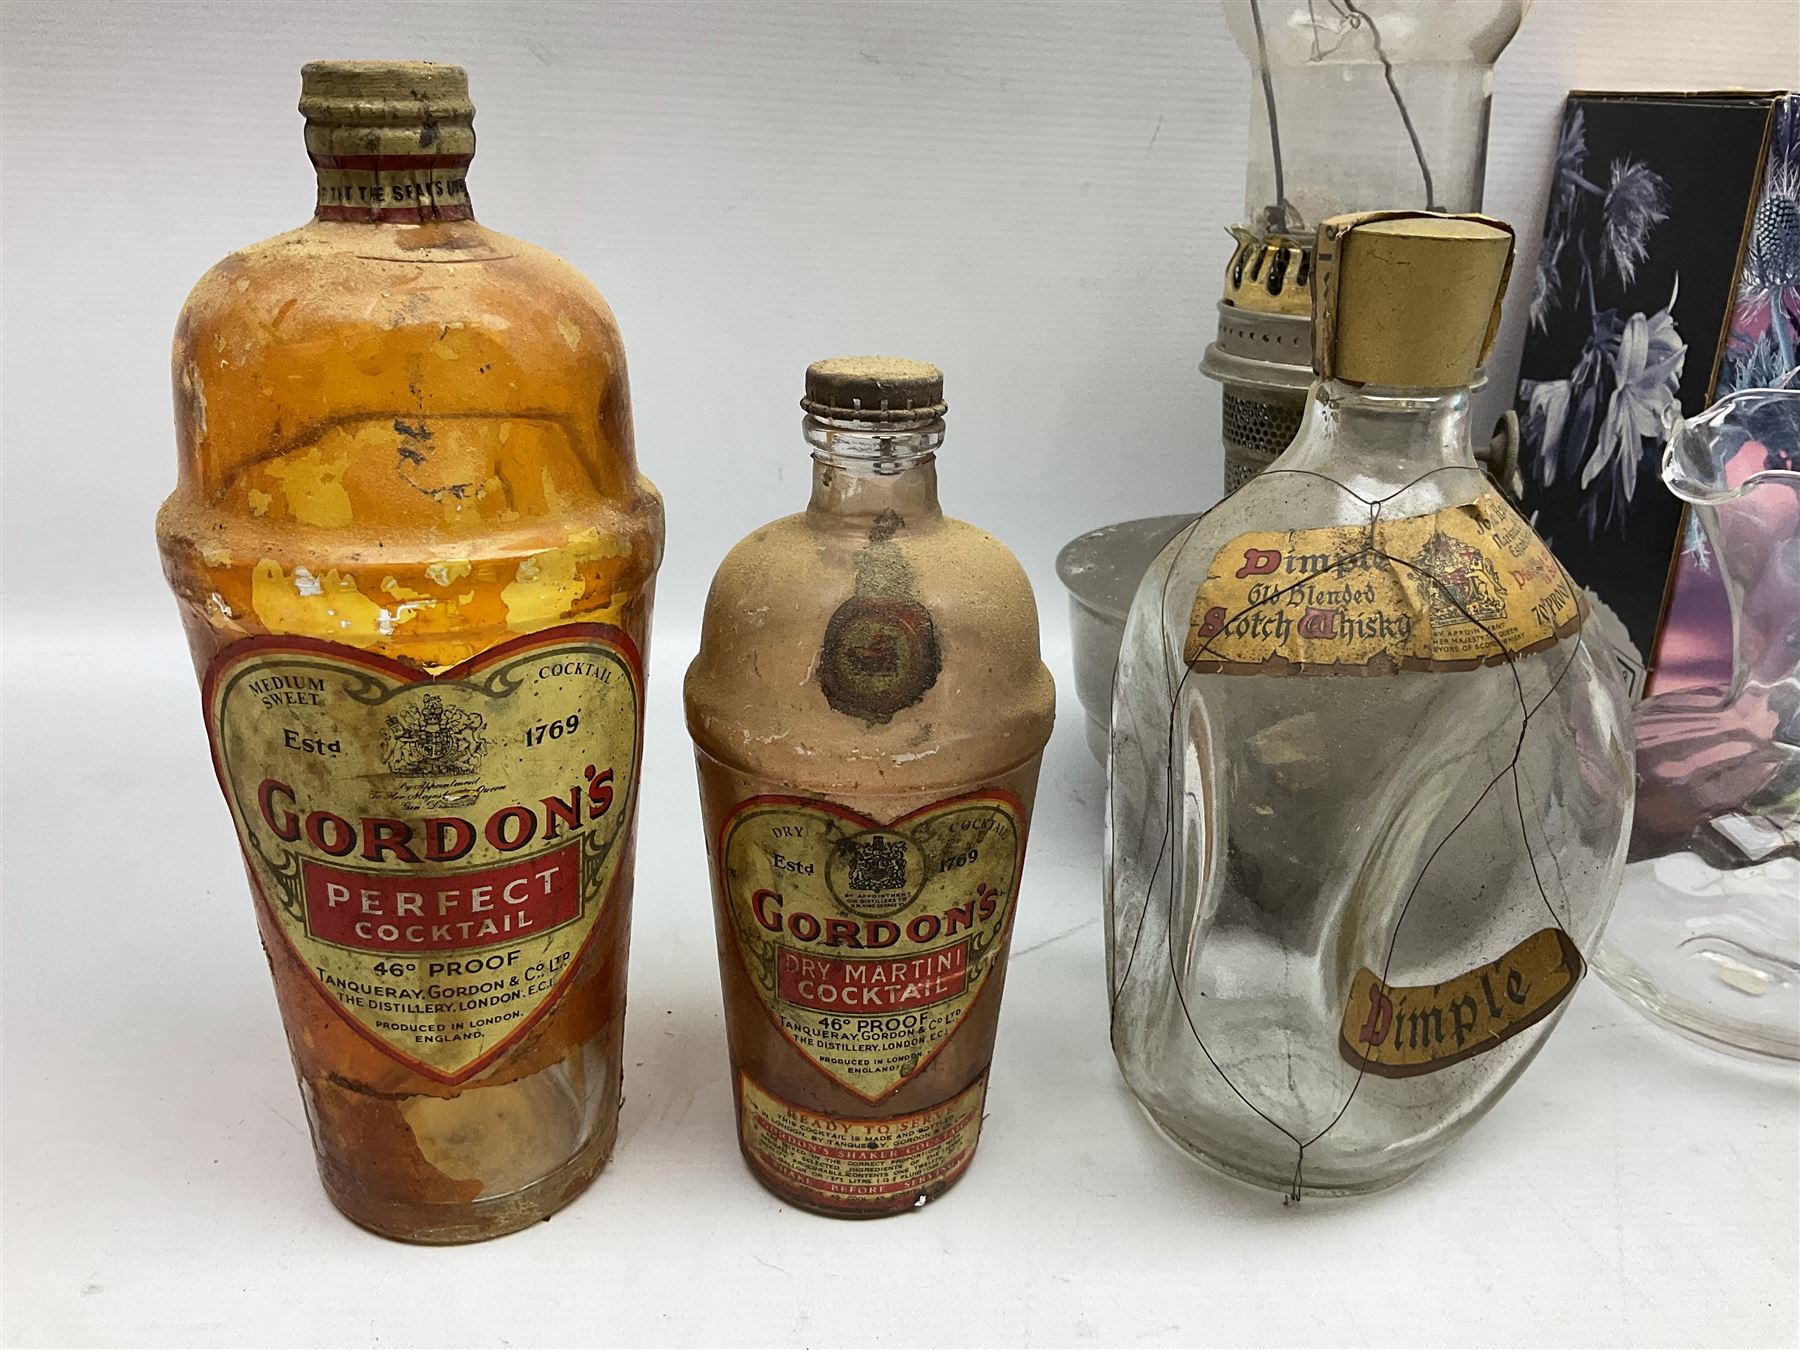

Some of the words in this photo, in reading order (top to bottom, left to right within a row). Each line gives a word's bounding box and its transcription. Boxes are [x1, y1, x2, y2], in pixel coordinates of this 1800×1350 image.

[1235, 548, 1390, 580] Dimple
[1248, 582, 1281, 607] Old
[1286, 582, 1376, 607] Blended
[1200, 607, 1294, 647] Scotch
[1297, 606, 1412, 649] Whisky
[1451, 635, 1484, 644] MAJESTY
[1499, 626, 1519, 637] QUEEN
[538, 661, 612, 685] COCKTAIL
[248, 675, 326, 698] MEDIUM
[262, 691, 320, 711] SWEET
[283, 728, 341, 759] Estd
[524, 713, 580, 749] 1769
[257, 763, 616, 864] GORDON'S
[772, 825, 805, 839] DRY
[772, 852, 814, 876] Estd
[938, 849, 979, 874] 1769
[326, 866, 560, 919] PERFECT
[355, 910, 533, 943] COCKTAIL
[751, 883, 998, 949] GORDON'S
[429, 949, 521, 979] PROOF
[785, 954, 830, 980] DRY
[844, 950, 961, 984] MARTINI
[337, 992, 363, 1010] THE
[428, 977, 505, 1001] GORDON
[509, 976, 520, 987] &
[798, 975, 948, 1005] COCKTAIL
[1359, 967, 1532, 1050] Dimple
[376, 1020, 446, 1032] PRODUCED
[451, 1021, 465, 1032] IN
[857, 1011, 929, 1032] PROOF
[861, 1028, 914, 1041] GORDON
[917, 1026, 926, 1034] &
[793, 1034, 814, 1046] THE
[819, 1056, 870, 1065] PRODUCED
[778, 1114, 796, 1126] THIS
[800, 1125, 847, 1141] COCKTAIL
[896, 1131, 915, 1139] AND
[787, 1109, 851, 1133] READY
[864, 1125, 890, 1135] TO
[811, 1135, 825, 1143] BY
[893, 1132, 931, 1146] GORDON
[801, 1156, 840, 1169] SELECTED
[849, 1164, 903, 1172] INGREDIENTS
[838, 1149, 898, 1159] SHAKER
[831, 1184, 886, 1194] BEFORE
